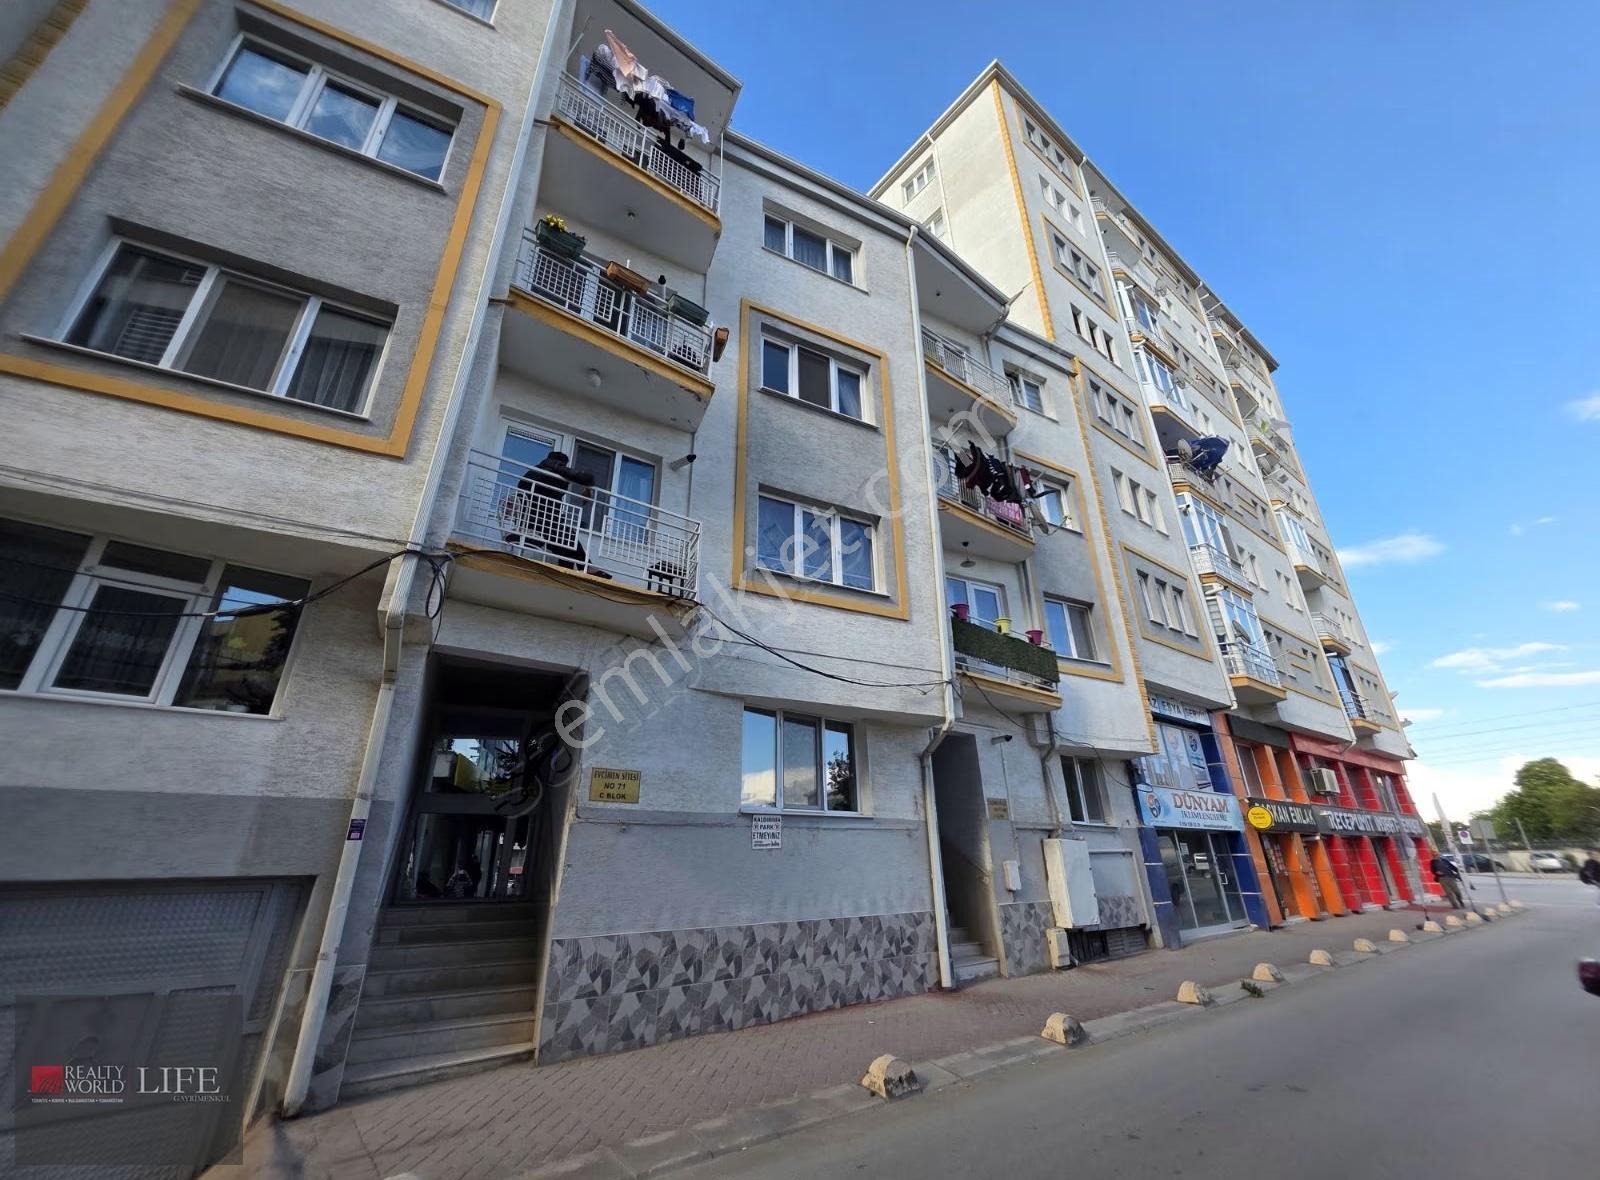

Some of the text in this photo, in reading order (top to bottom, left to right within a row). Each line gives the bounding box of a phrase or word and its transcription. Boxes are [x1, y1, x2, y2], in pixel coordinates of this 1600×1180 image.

[617, 782, 626, 790] 71
[606, 792, 626, 800] BLOK
[1172, 791, 1230, 813] DÜNYAM
[1288, 807, 1316, 825] EMLAK
